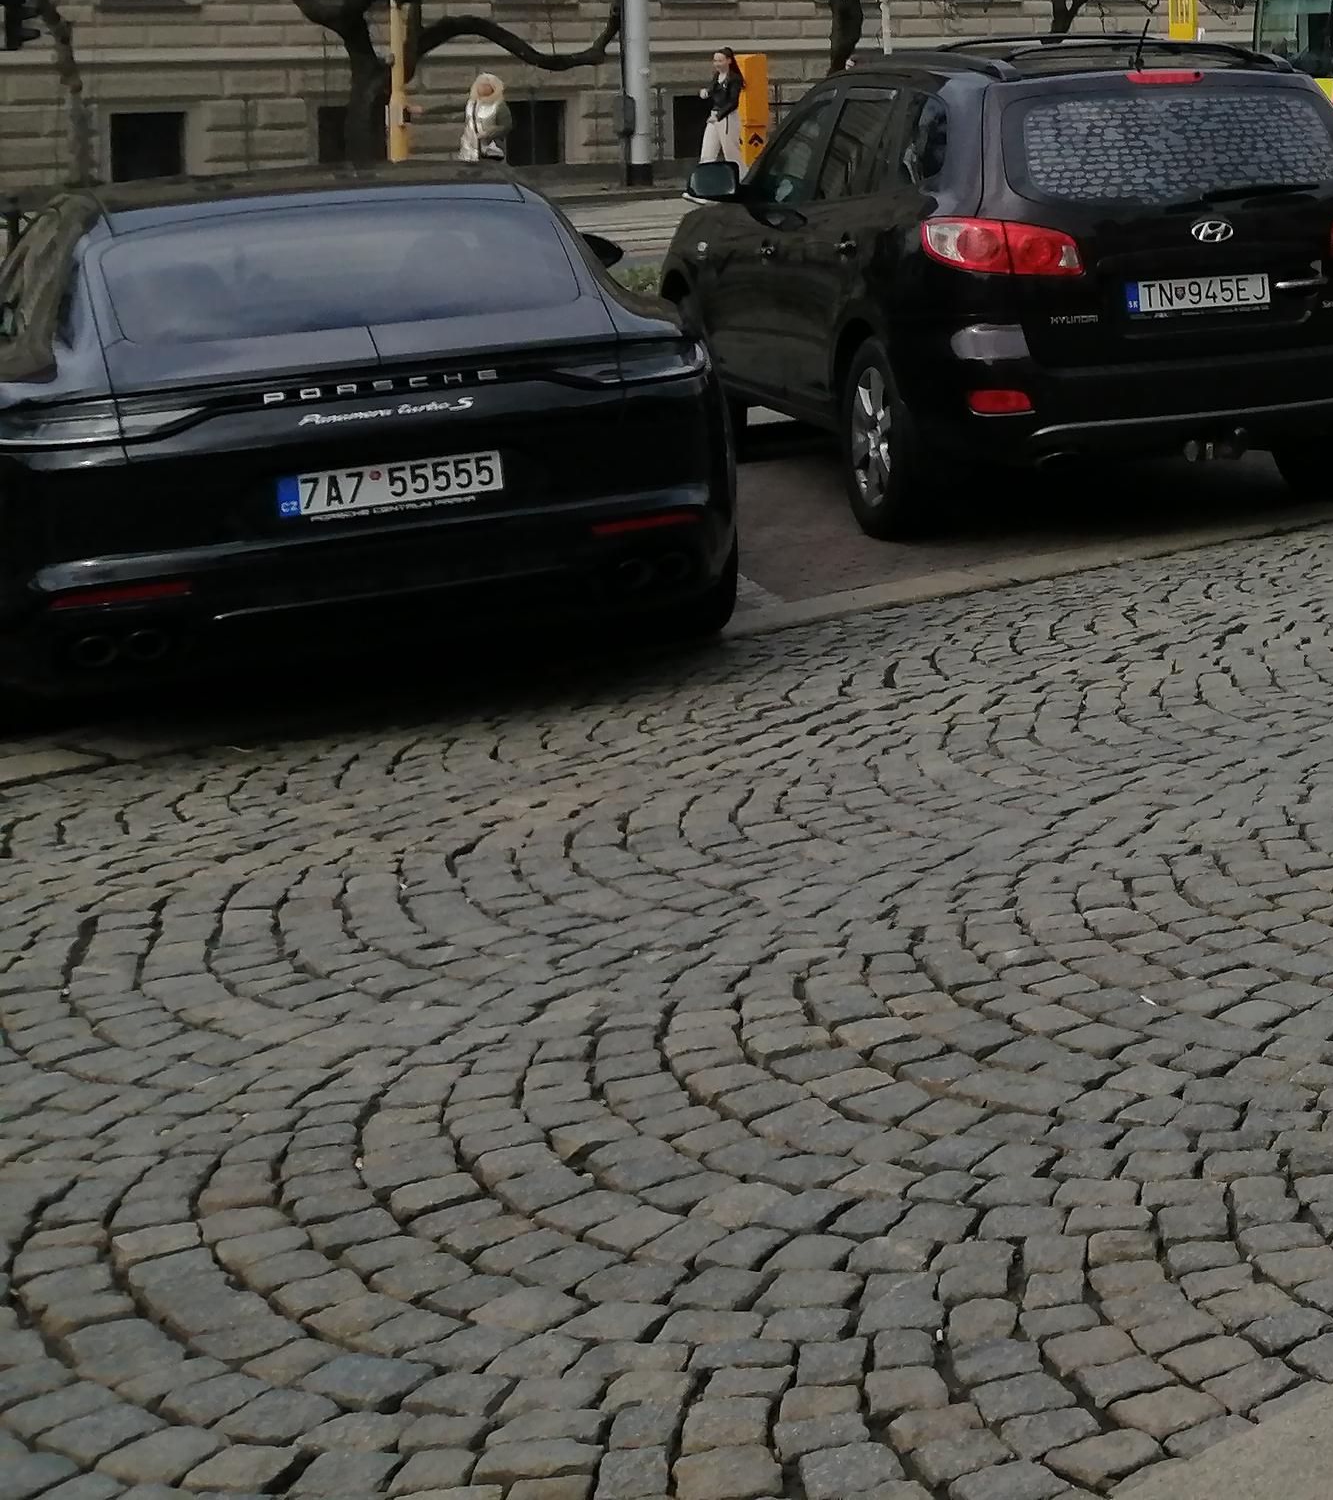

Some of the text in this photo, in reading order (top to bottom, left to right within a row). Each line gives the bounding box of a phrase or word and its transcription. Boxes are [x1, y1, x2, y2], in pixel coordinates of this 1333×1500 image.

[1142, 276, 1267, 309] TN 945EJ
[263, 369, 498, 405] PORSCHE
[300, 455, 494, 510] 7A7 55555
[280, 500, 299, 513] CZ
